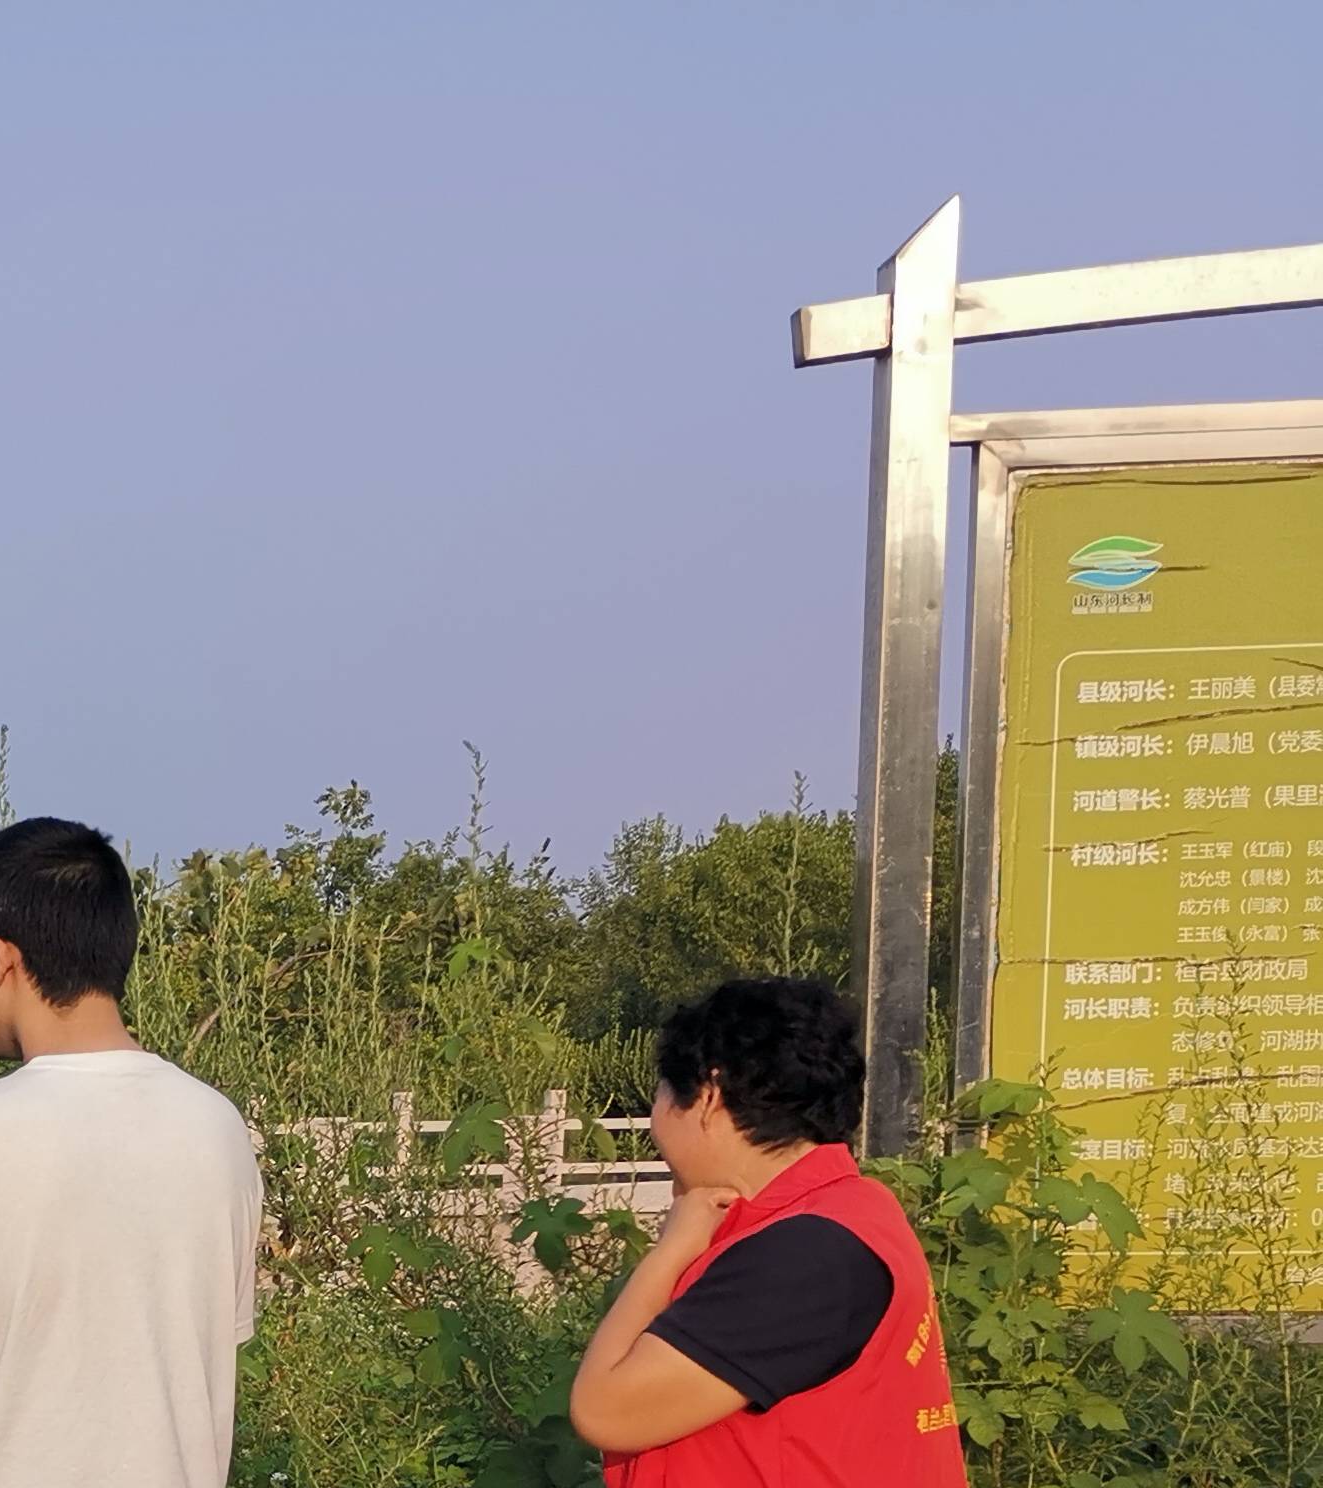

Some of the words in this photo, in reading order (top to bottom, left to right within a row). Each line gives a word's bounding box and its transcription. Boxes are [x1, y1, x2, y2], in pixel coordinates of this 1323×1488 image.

[1077, 678, 1175, 704] 县级河长：
[1075, 734, 1174, 759] 镇级河长：
[1073, 787, 1171, 812] 河道警长：
[1183, 784, 1323, 810] 蔡光普（果里
[1070, 842, 1168, 867] 村级河长：
[1065, 960, 1162, 984] 联系部门：
[1175, 959, 1308, 983] 桓台县财政局
[1063, 997, 1159, 1020] 河长职责：
[1061, 1067, 1154, 1090] 总体目标：
[1167, 1064, 1323, 1089] 乱占乱建、乱围
[1069, 1138, 1154, 1160] 度目标：
[1167, 1136, 1323, 1160] 河流水质基本达
